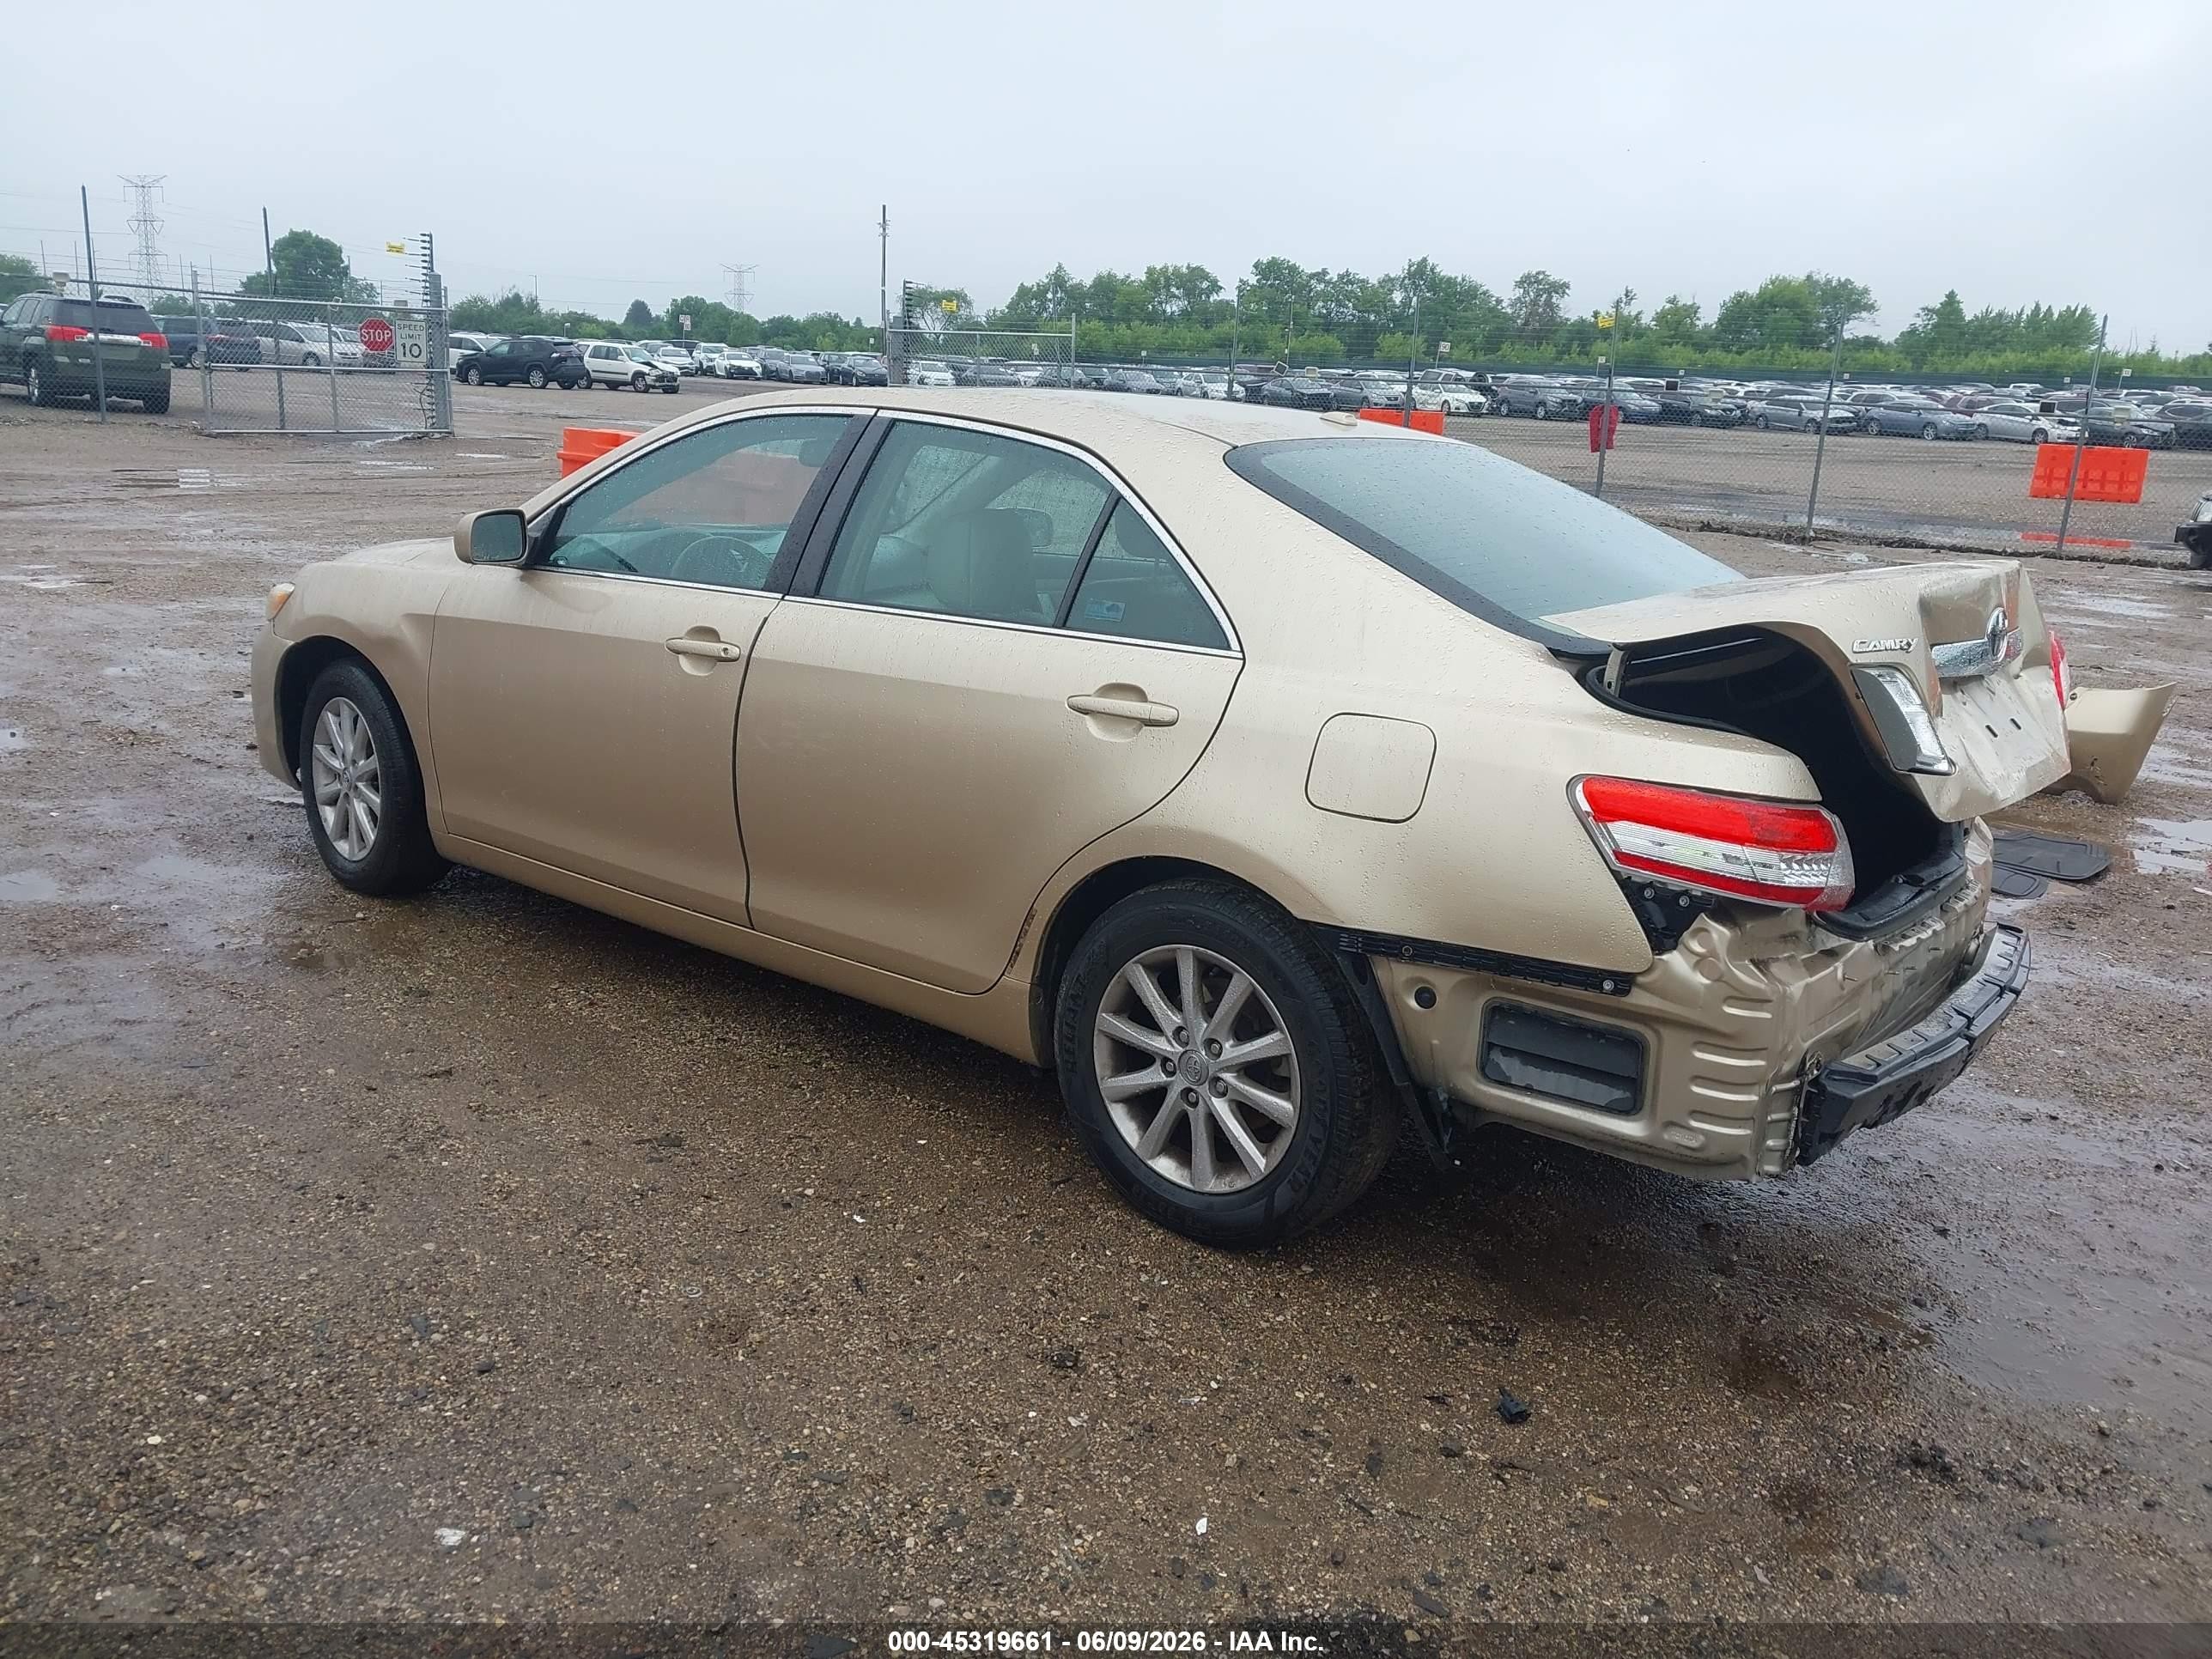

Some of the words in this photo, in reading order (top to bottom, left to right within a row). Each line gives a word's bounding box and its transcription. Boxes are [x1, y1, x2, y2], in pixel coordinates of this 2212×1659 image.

[397, 323, 425, 331] SPEED
[361, 329, 392, 342] STOP
[400, 332, 422, 341] LIMIT
[401, 342, 422, 359] 10
[1852, 637, 1919, 653] CAMRY
